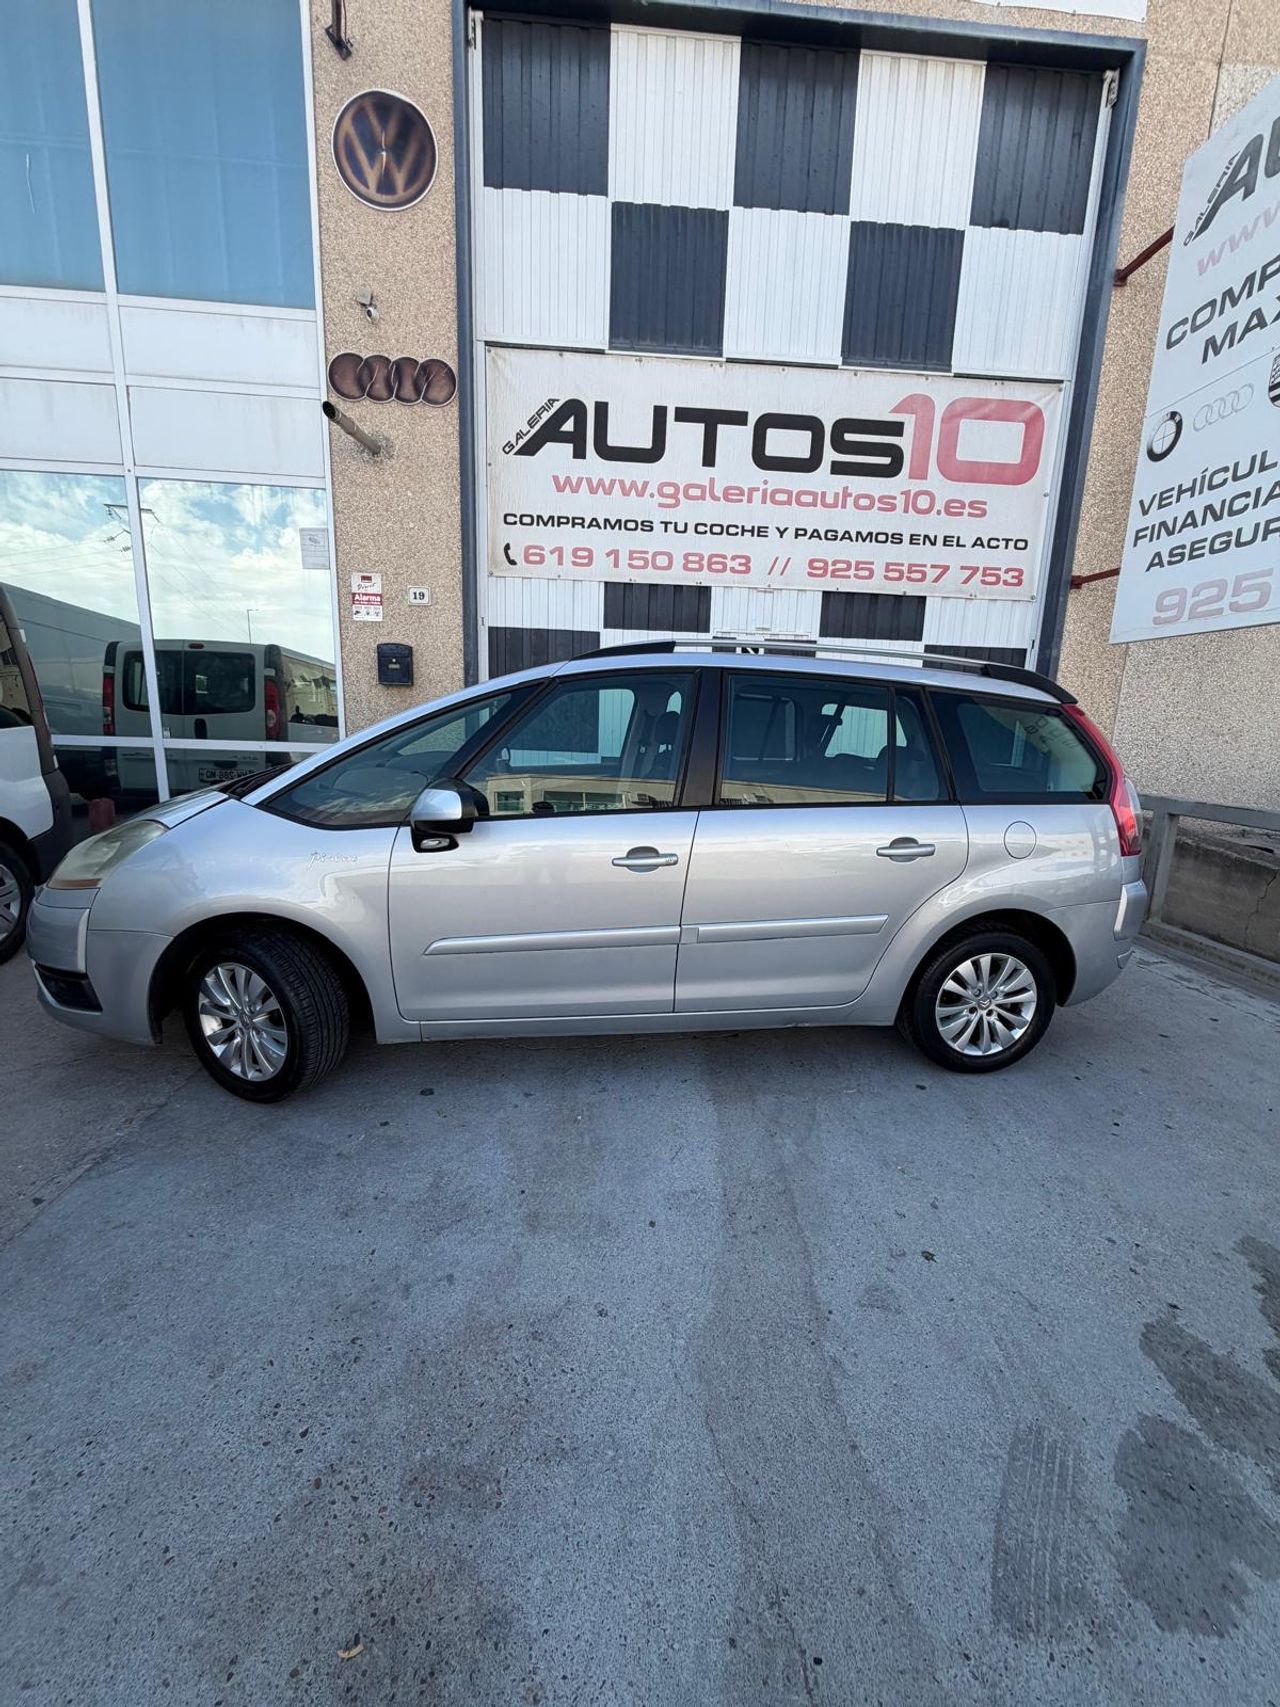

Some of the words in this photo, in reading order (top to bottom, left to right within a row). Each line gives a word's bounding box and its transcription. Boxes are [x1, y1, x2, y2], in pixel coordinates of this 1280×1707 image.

[1201, 295, 1280, 365] MA
[502, 398, 560, 455] GALERIA
[552, 474, 988, 518] www.galeriaautos10.es
[1138, 450, 1279, 517] VEHÍCUL
[503, 513, 655, 532] COMPRAMOS
[660, 520, 688, 534] TU
[694, 523, 769, 538] COCHE
[775, 527, 790, 538] Y
[794, 527, 904, 545] PAGAMOS
[909, 533, 938, 546] EN
[942, 535, 967, 548] EL
[971, 537, 1029, 550] ACTO
[523, 545, 595, 568] 619
[605, 549, 674, 571] 150
[682, 552, 752, 575] 863
[807, 558, 875, 581] 925
[884, 562, 950, 584] 557
[960, 565, 1025, 587] 753
[354, 593, 381, 602] Alarma
[413, 592, 425, 600] 19
[1152, 568, 1274, 626] 925
